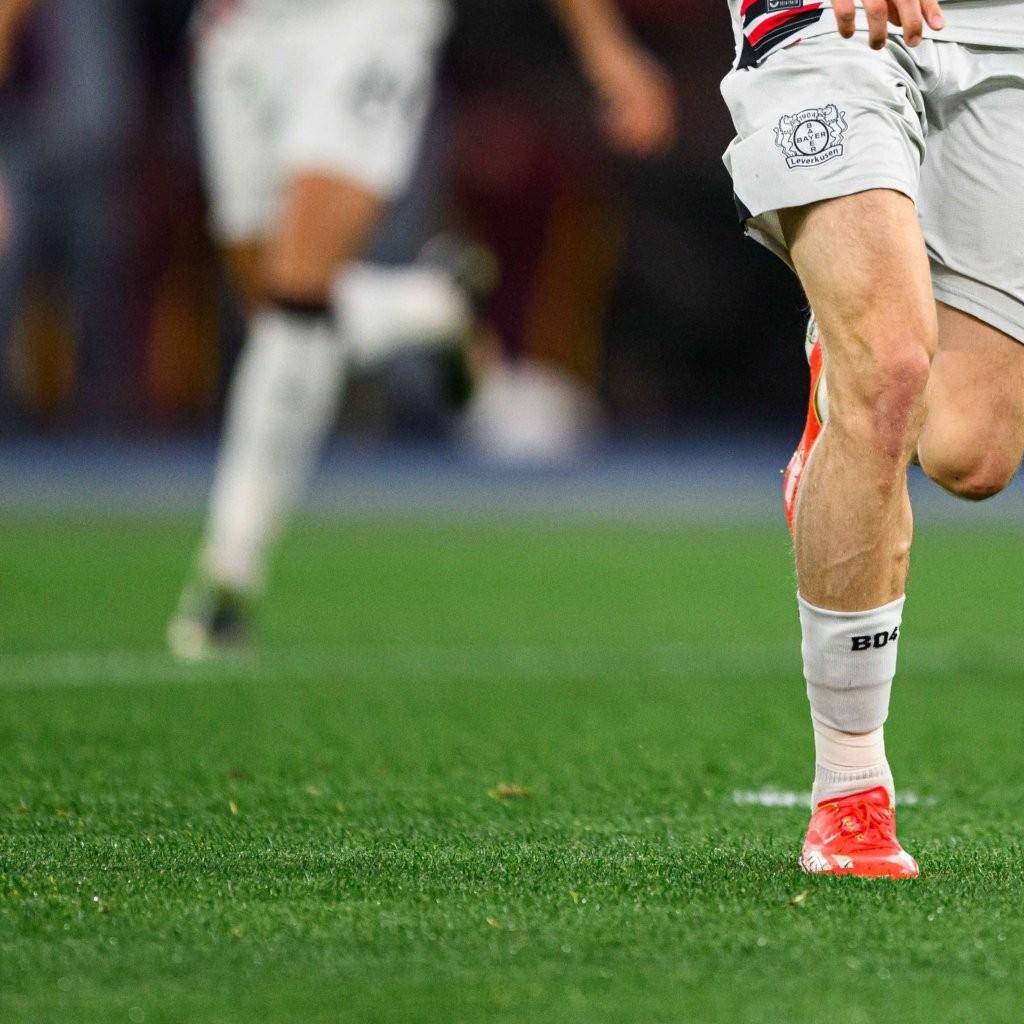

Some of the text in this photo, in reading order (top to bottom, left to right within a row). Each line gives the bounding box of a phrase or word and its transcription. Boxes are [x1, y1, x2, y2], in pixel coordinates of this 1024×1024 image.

[796, 131, 826, 144] BAYER
[806, 122, 817, 153] BAYER
[790, 148, 839, 165] Leverkusen
